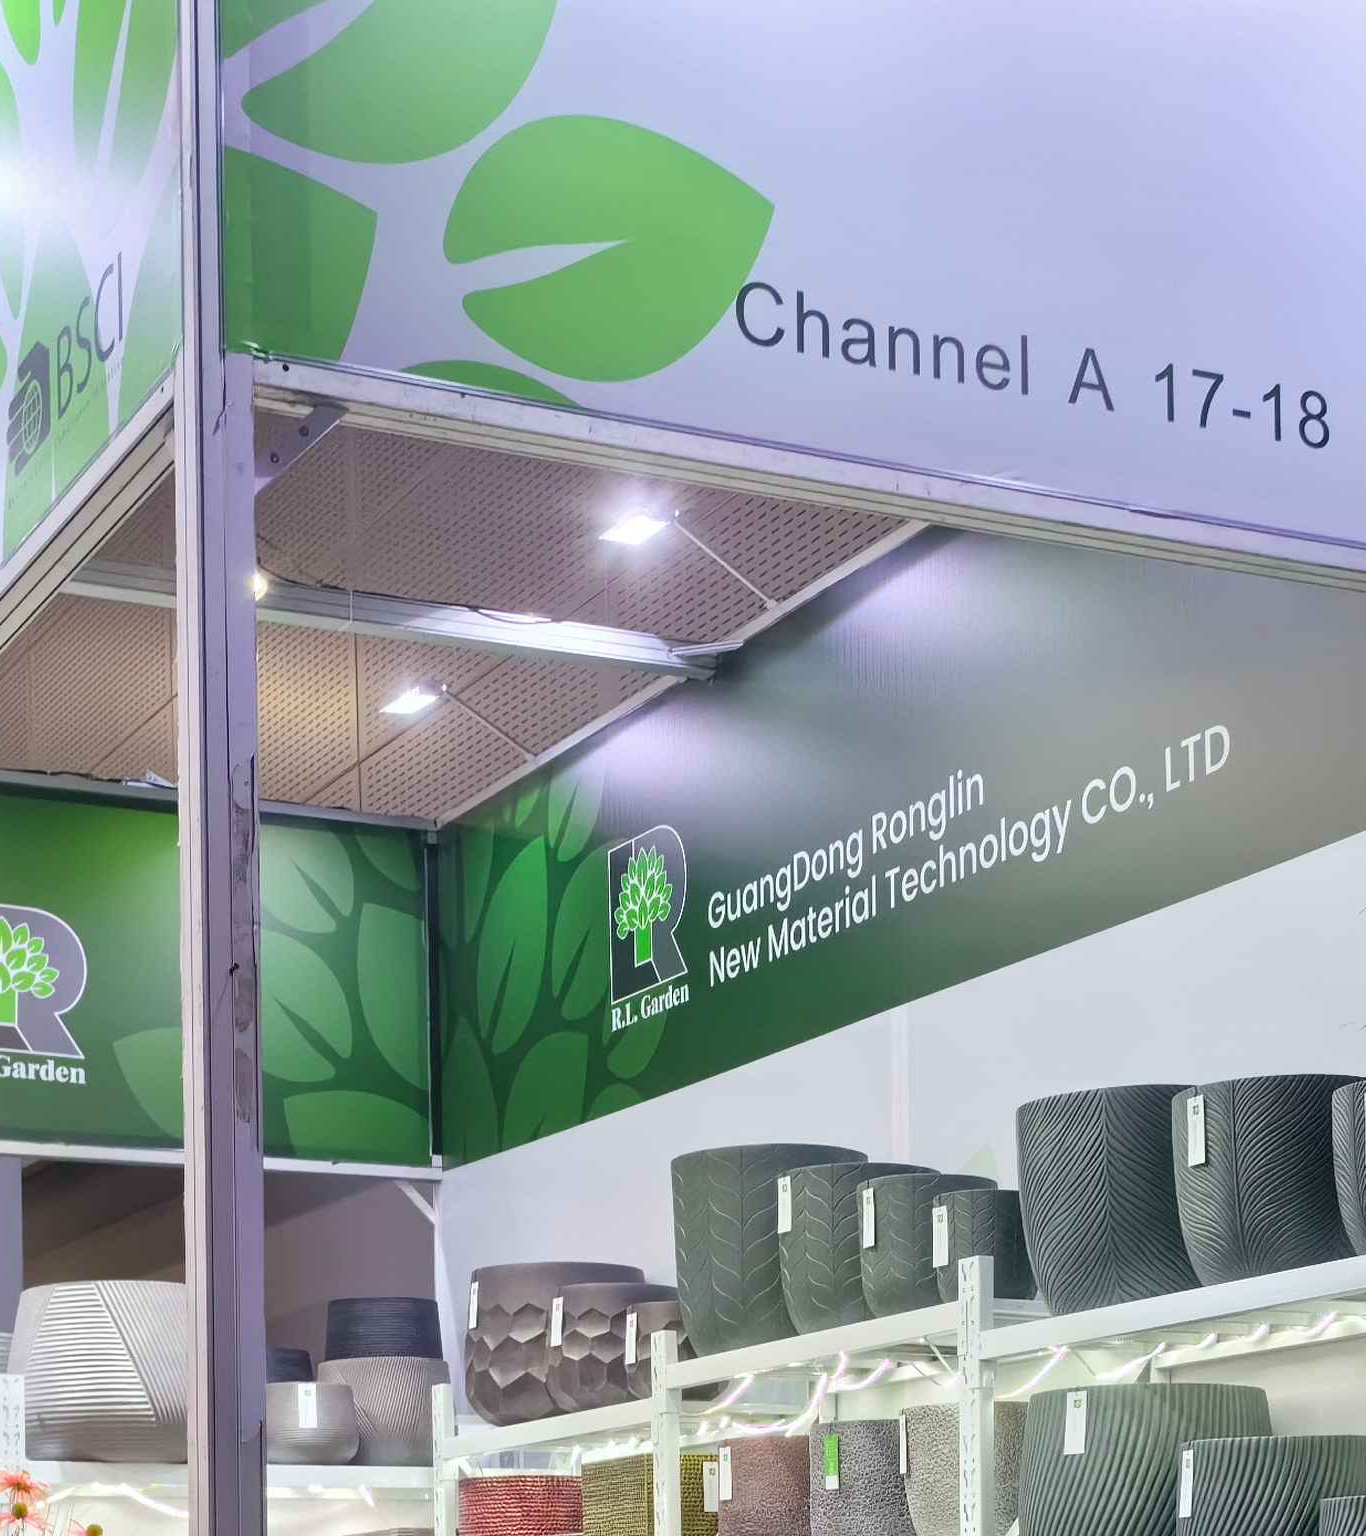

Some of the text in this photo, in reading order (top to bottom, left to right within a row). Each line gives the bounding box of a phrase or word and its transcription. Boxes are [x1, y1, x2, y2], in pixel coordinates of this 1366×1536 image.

[57, 251, 123, 420] BSCI
[735, 281, 1030, 395] Channel
[1068, 346, 1115, 411] A
[1154, 363, 1331, 450] 17-18
[707, 769, 985, 929] GuangDong Ronglin
[708, 939, 760, 987] New
[767, 879, 877, 962] Material
[886, 800, 1071, 908] Technology
[1164, 724, 1231, 792] LTD
[610, 983, 690, 1032] R.L. Garden
